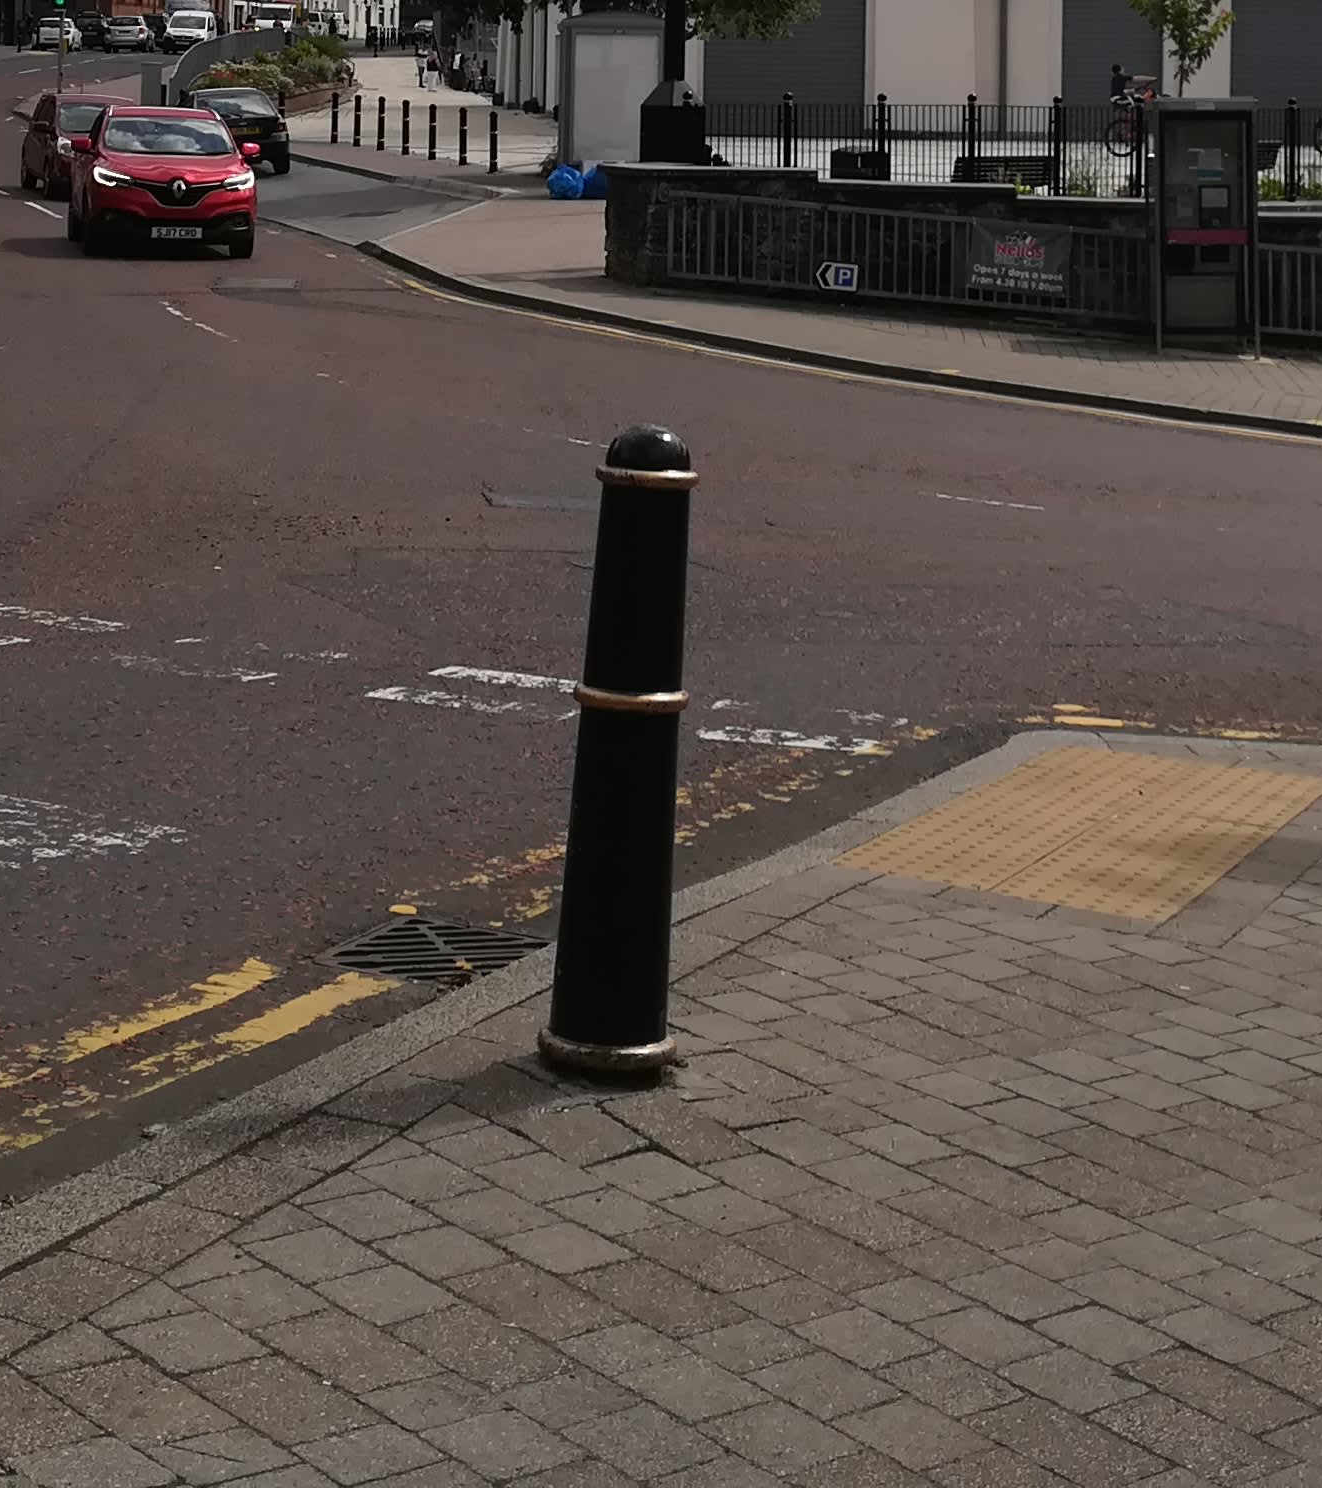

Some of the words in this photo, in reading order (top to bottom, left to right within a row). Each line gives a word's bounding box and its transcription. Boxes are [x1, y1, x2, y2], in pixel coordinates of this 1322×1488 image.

[838, 269, 851, 285] P
[972, 275, 993, 284] From
[974, 264, 998, 275] Open
[1001, 267, 1005, 275] 7
[1008, 268, 1029, 279] days
[1040, 273, 1063, 281] week
